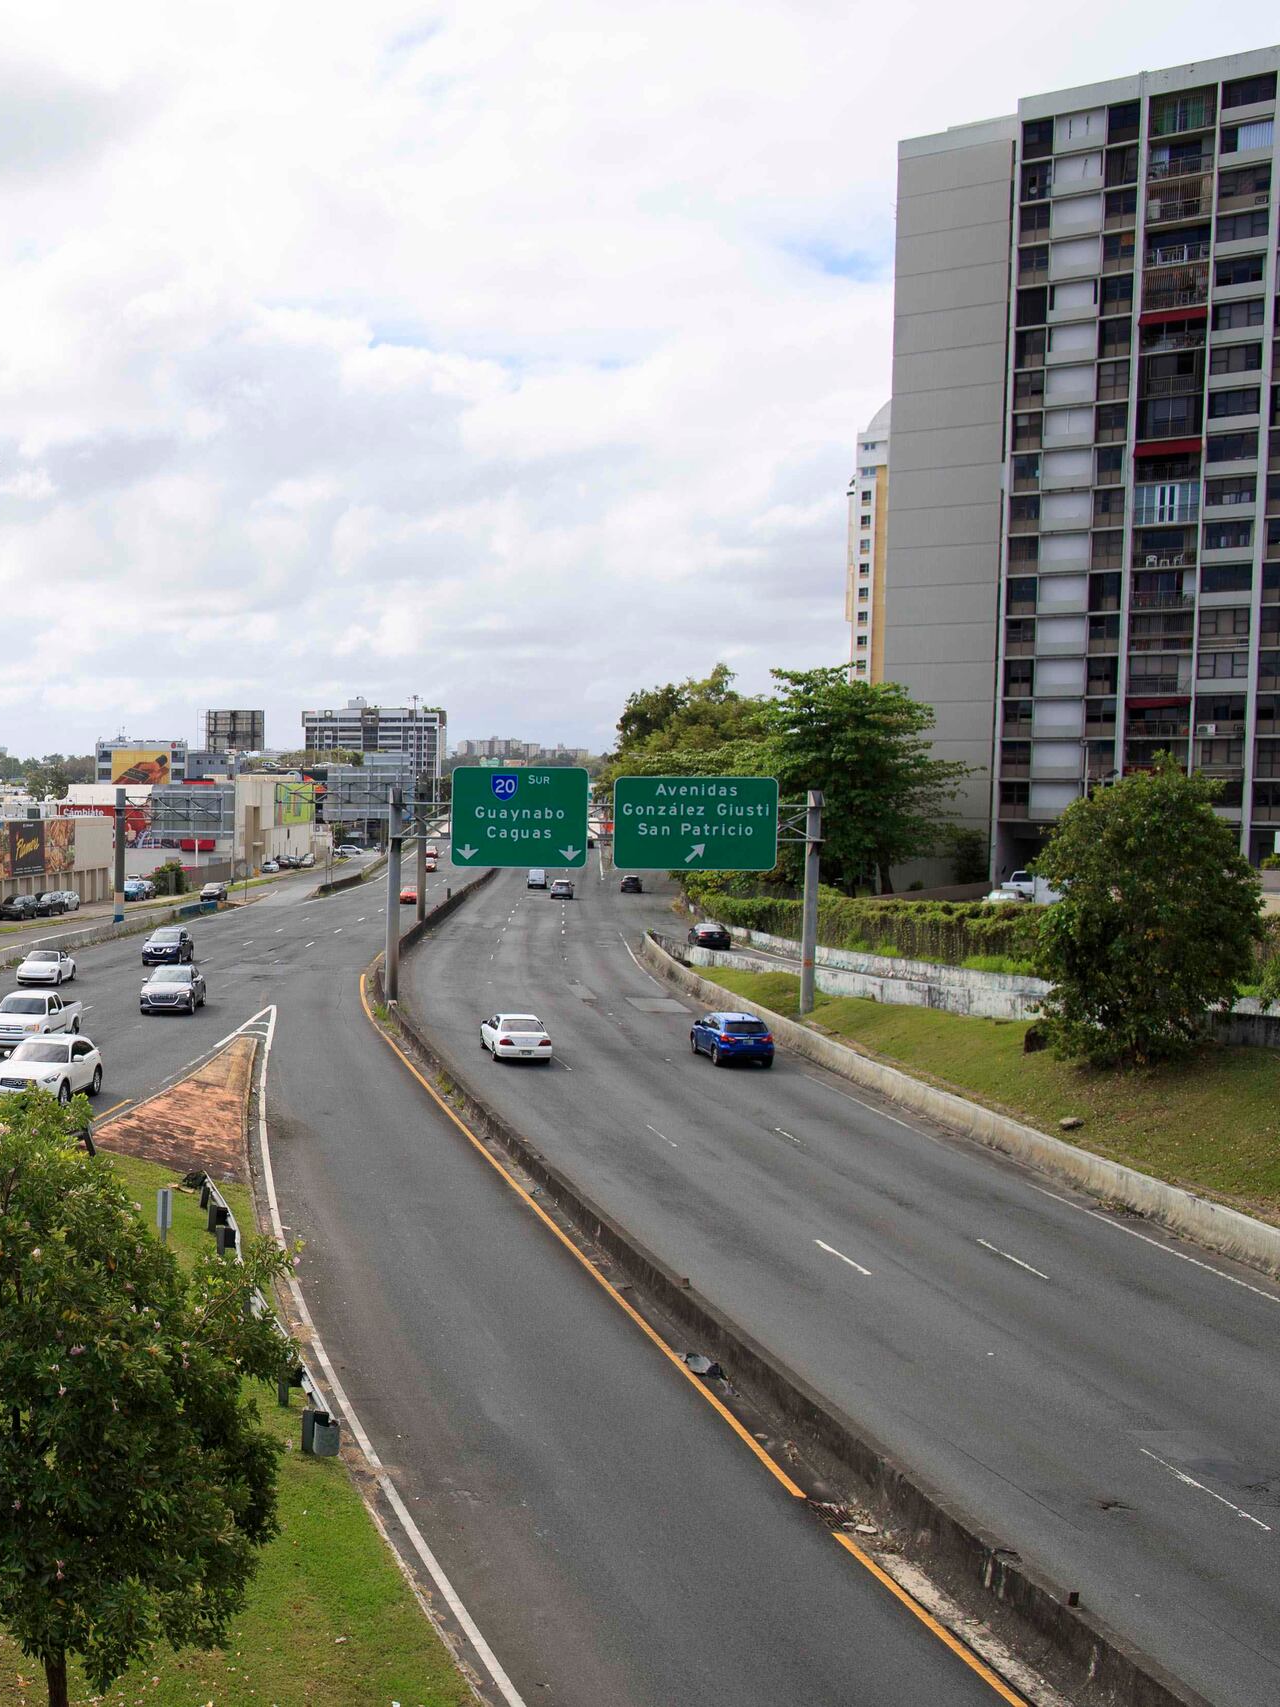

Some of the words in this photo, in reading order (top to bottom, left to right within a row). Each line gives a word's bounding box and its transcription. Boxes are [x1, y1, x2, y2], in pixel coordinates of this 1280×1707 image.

[495, 779, 515, 793] 20
[528, 774, 550, 785] SUR
[655, 783, 738, 797] Avenidas
[474, 806, 565, 821] Guaynabo
[622, 802, 705, 816] González
[716, 803, 770, 816] Giusti
[486, 826, 552, 841] Caguas
[638, 823, 670, 836] San
[680, 823, 754, 836] Patricio
